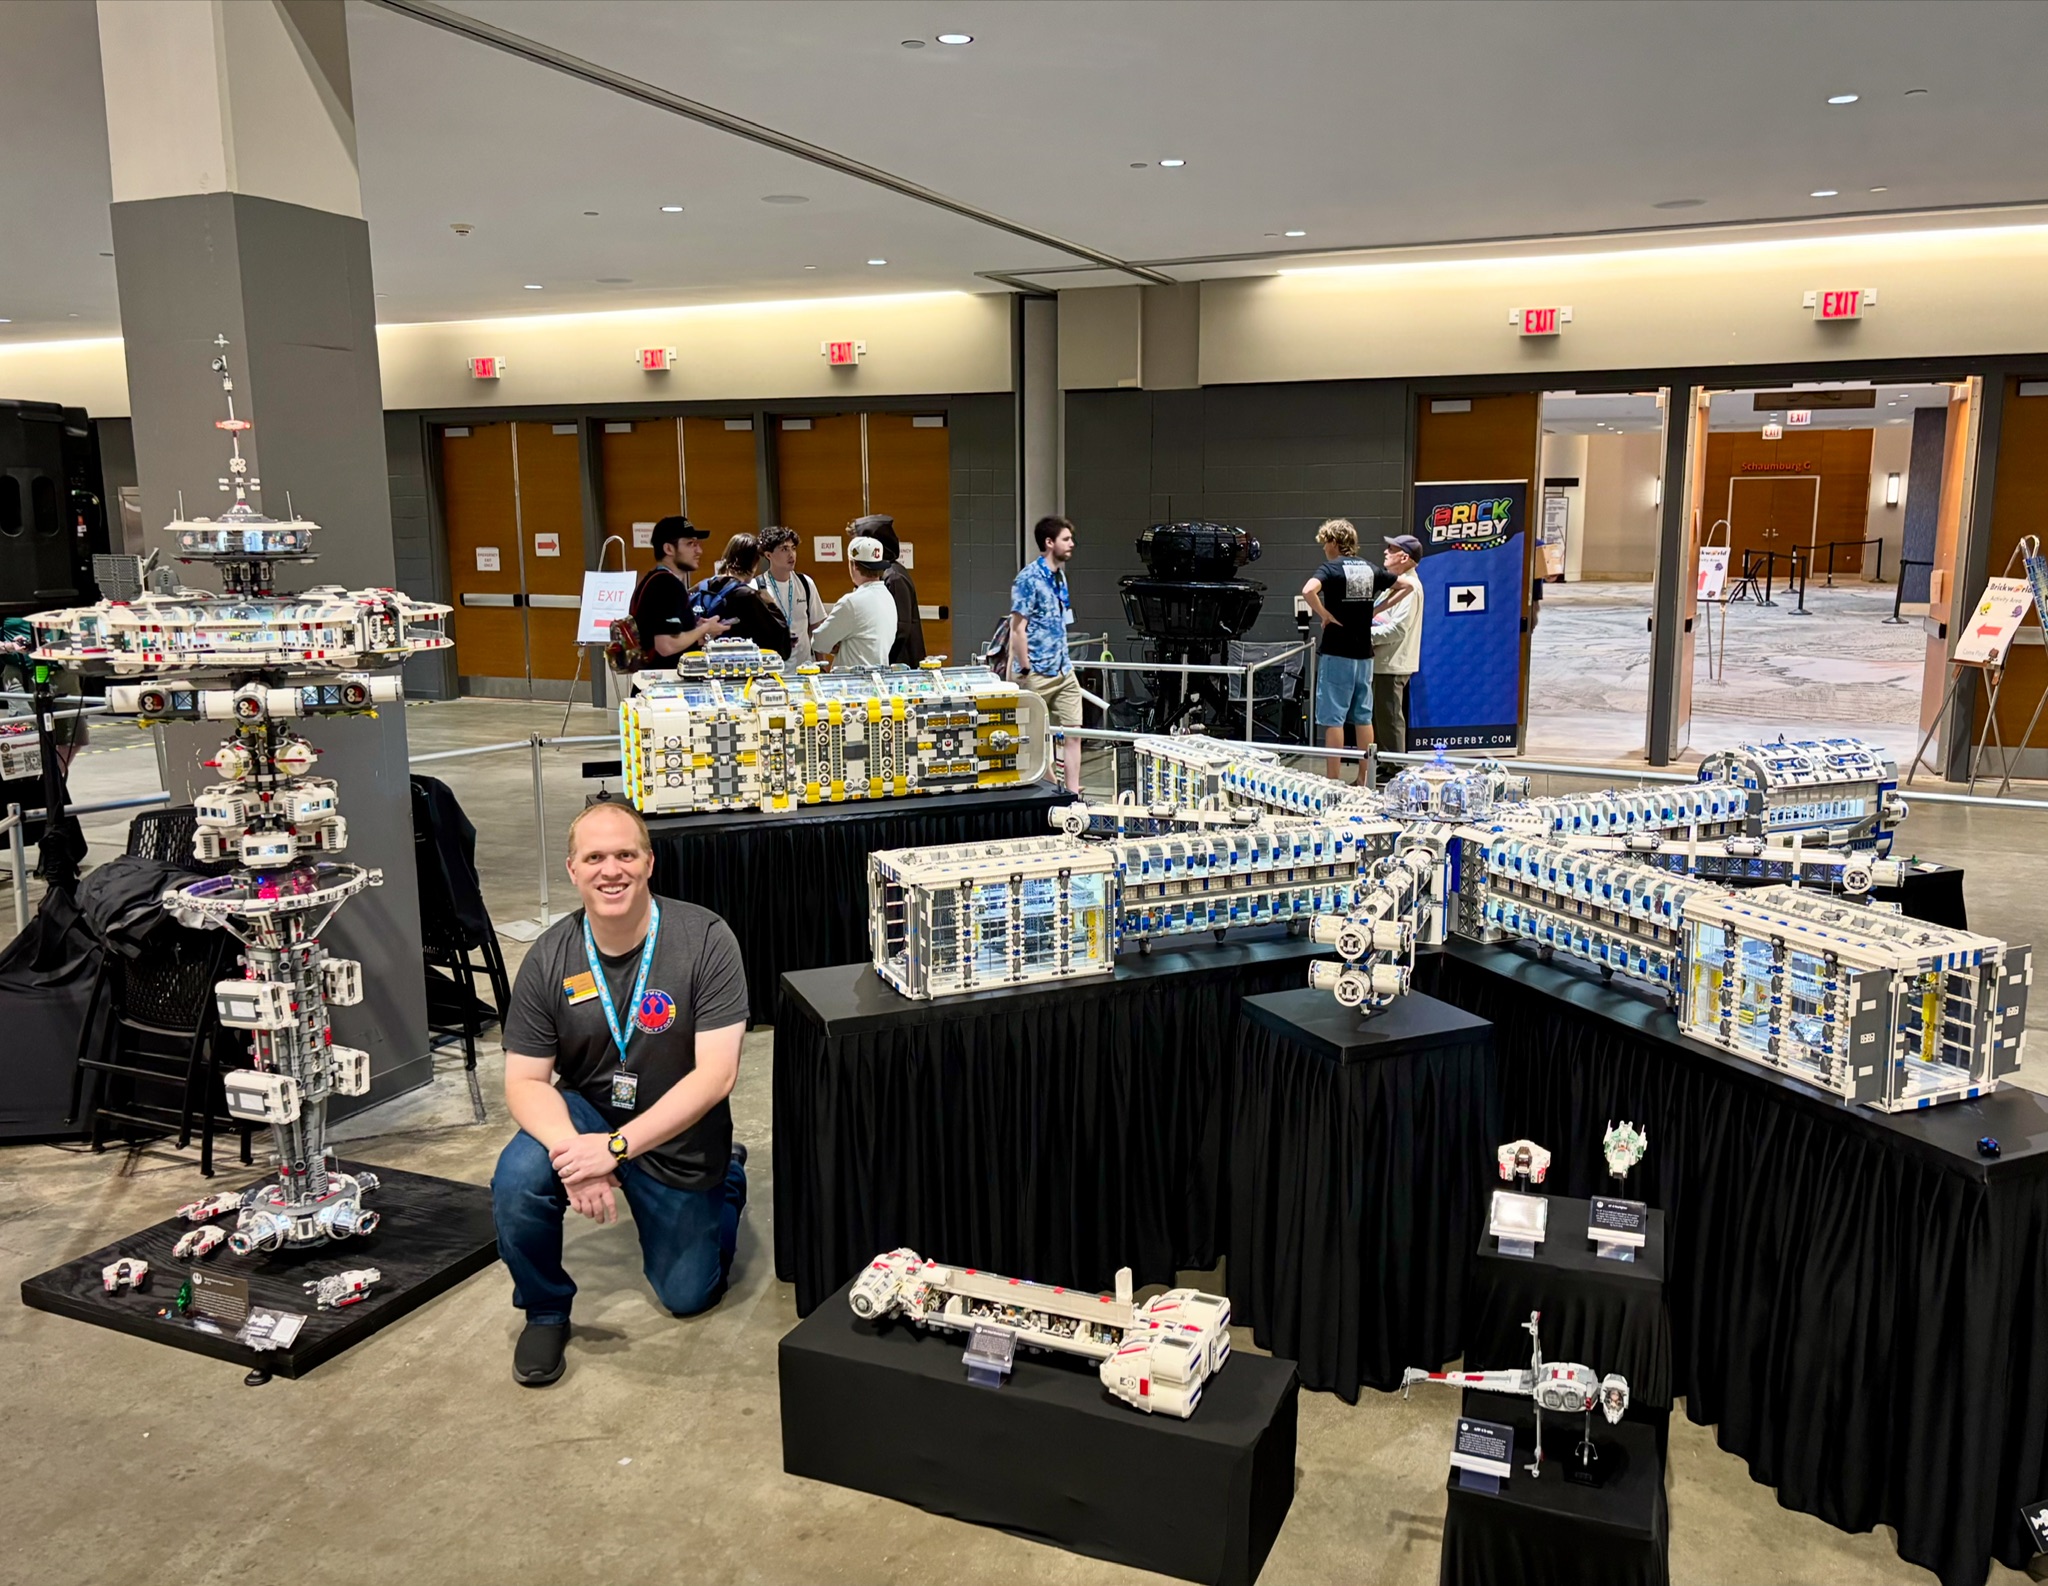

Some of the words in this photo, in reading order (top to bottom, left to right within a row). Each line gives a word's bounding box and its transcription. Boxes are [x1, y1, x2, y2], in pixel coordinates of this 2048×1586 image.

[1822, 291, 1859, 318] EXIT
[1525, 309, 1556, 334] EXIT
[643, 349, 664, 370] EXIT
[830, 342, 852, 364] EXIT
[474, 358, 495, 378] EXIT
[1790, 412, 1809, 423] EXIT
[1765, 429, 1779, 438] EXIT
[1742, 462, 1801, 472] Schaumburg
[1803, 461, 1811, 470] G
[1433, 500, 1511, 526] BRICK
[1431, 518, 1508, 543] DERBY
[598, 590, 625, 602] EXIT
[1415, 735, 1511, 746] BRICKDERBY.COM
